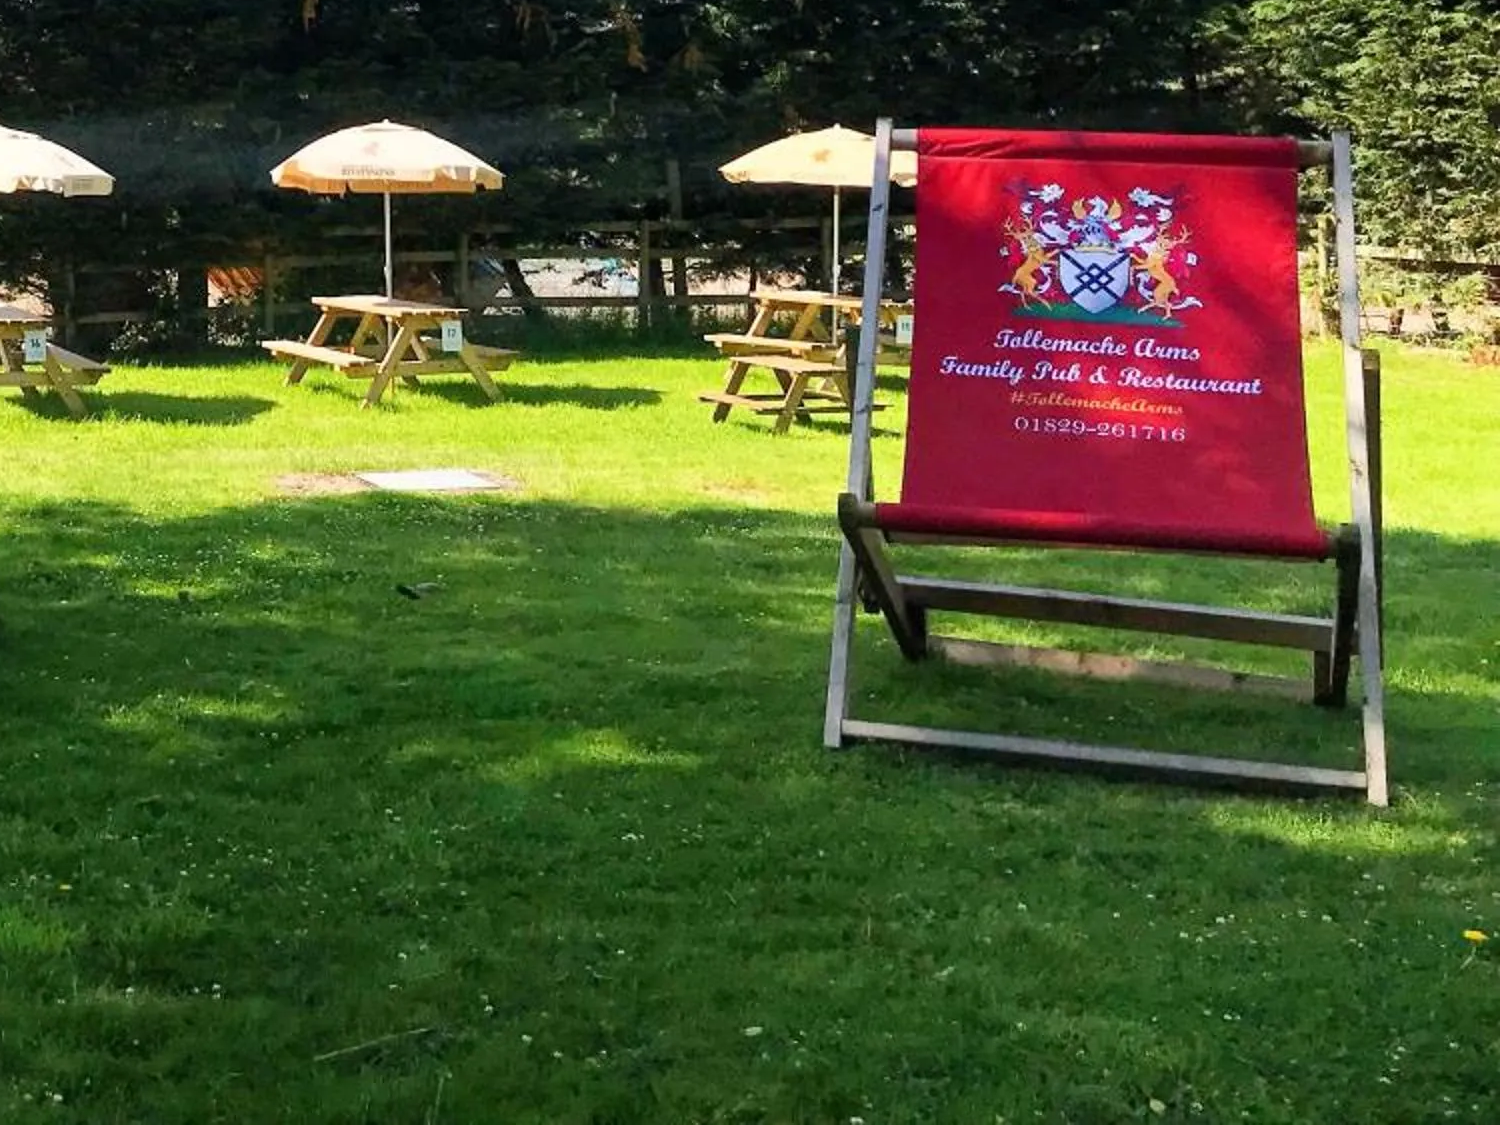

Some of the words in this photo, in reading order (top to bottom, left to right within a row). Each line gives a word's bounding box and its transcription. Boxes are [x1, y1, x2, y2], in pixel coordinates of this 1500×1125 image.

[993, 329, 1128, 356] Tollemache
[1134, 338, 1201, 362] Arms
[939, 356, 1025, 385] Family
[1031, 361, 1081, 382] Pub
[1089, 365, 1109, 384] &
[1117, 367, 1263, 395] Restaurant
[1011, 391, 1184, 416] #TollemacheArms
[1014, 416, 1186, 442] 01829-261716
